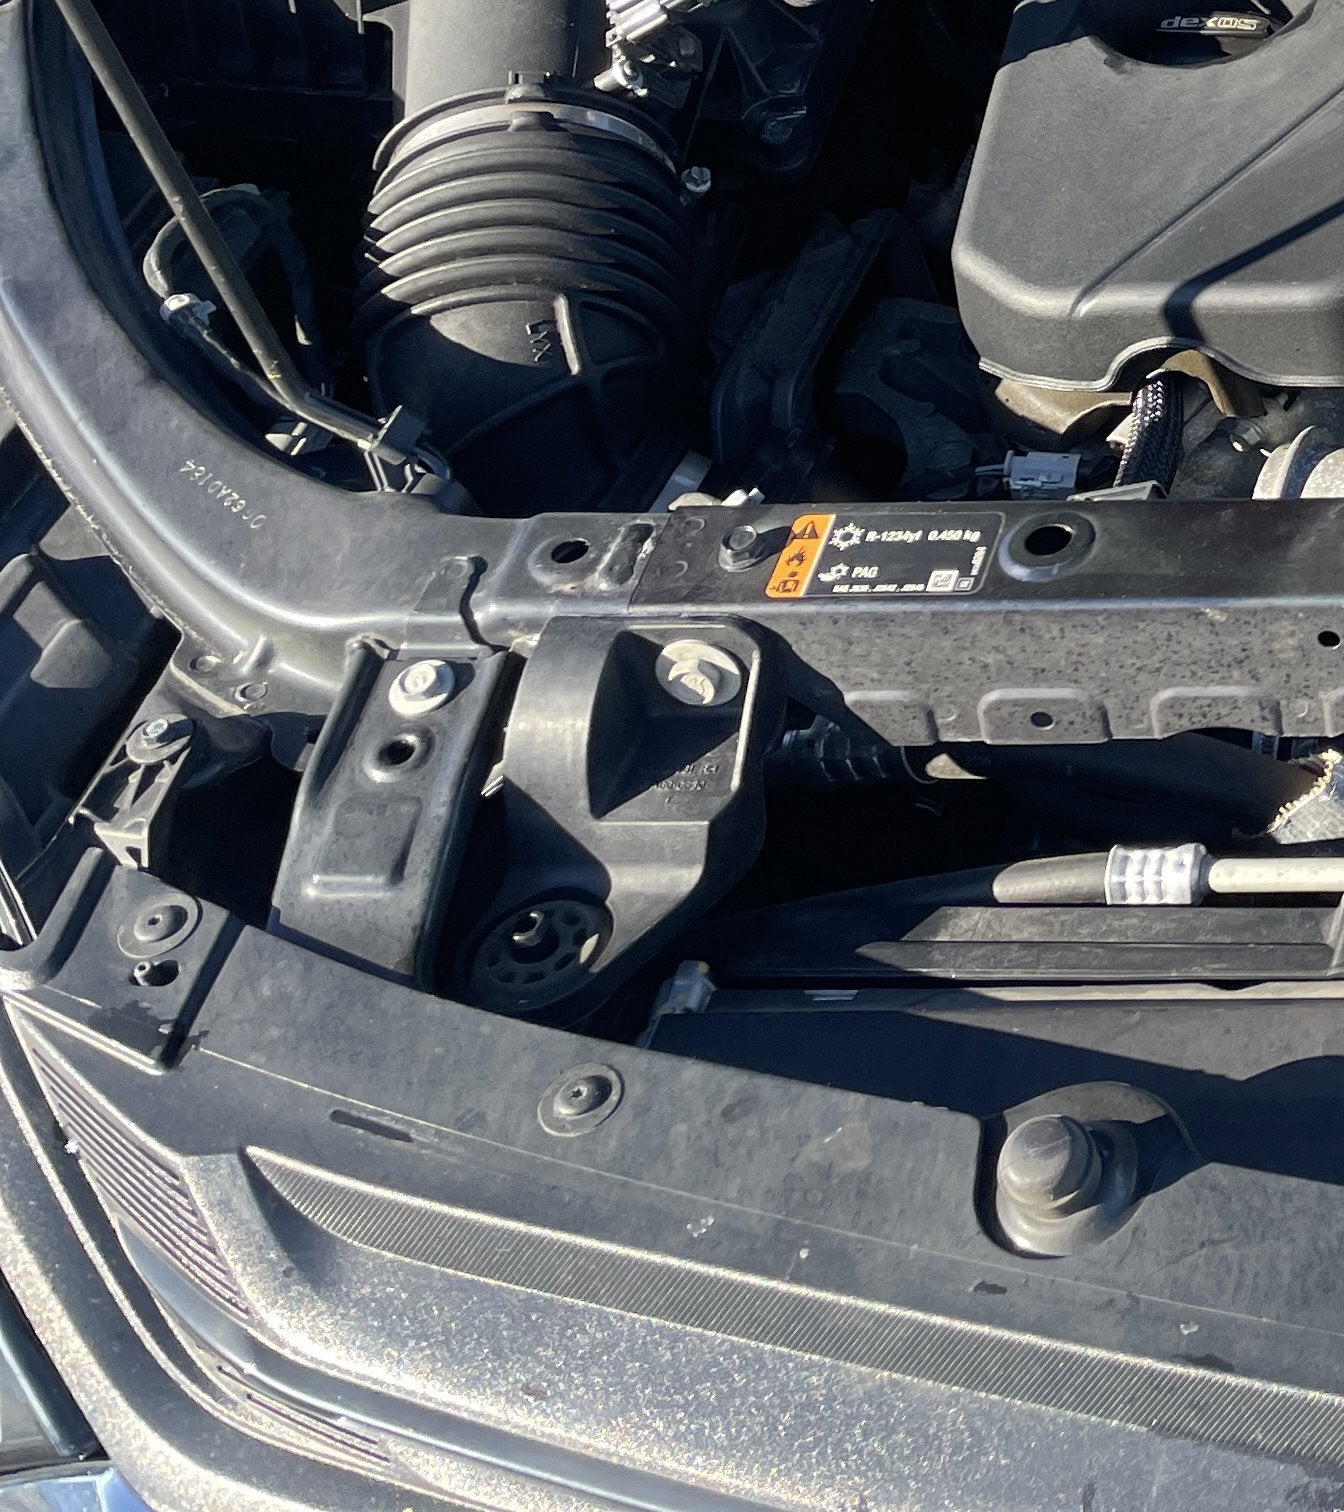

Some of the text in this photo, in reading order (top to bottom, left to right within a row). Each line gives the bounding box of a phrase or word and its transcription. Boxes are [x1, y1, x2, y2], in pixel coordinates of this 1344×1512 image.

[1160, 15, 1259, 31] dexos
[963, 529, 981, 543] kg
[851, 566, 879, 578] PAG
